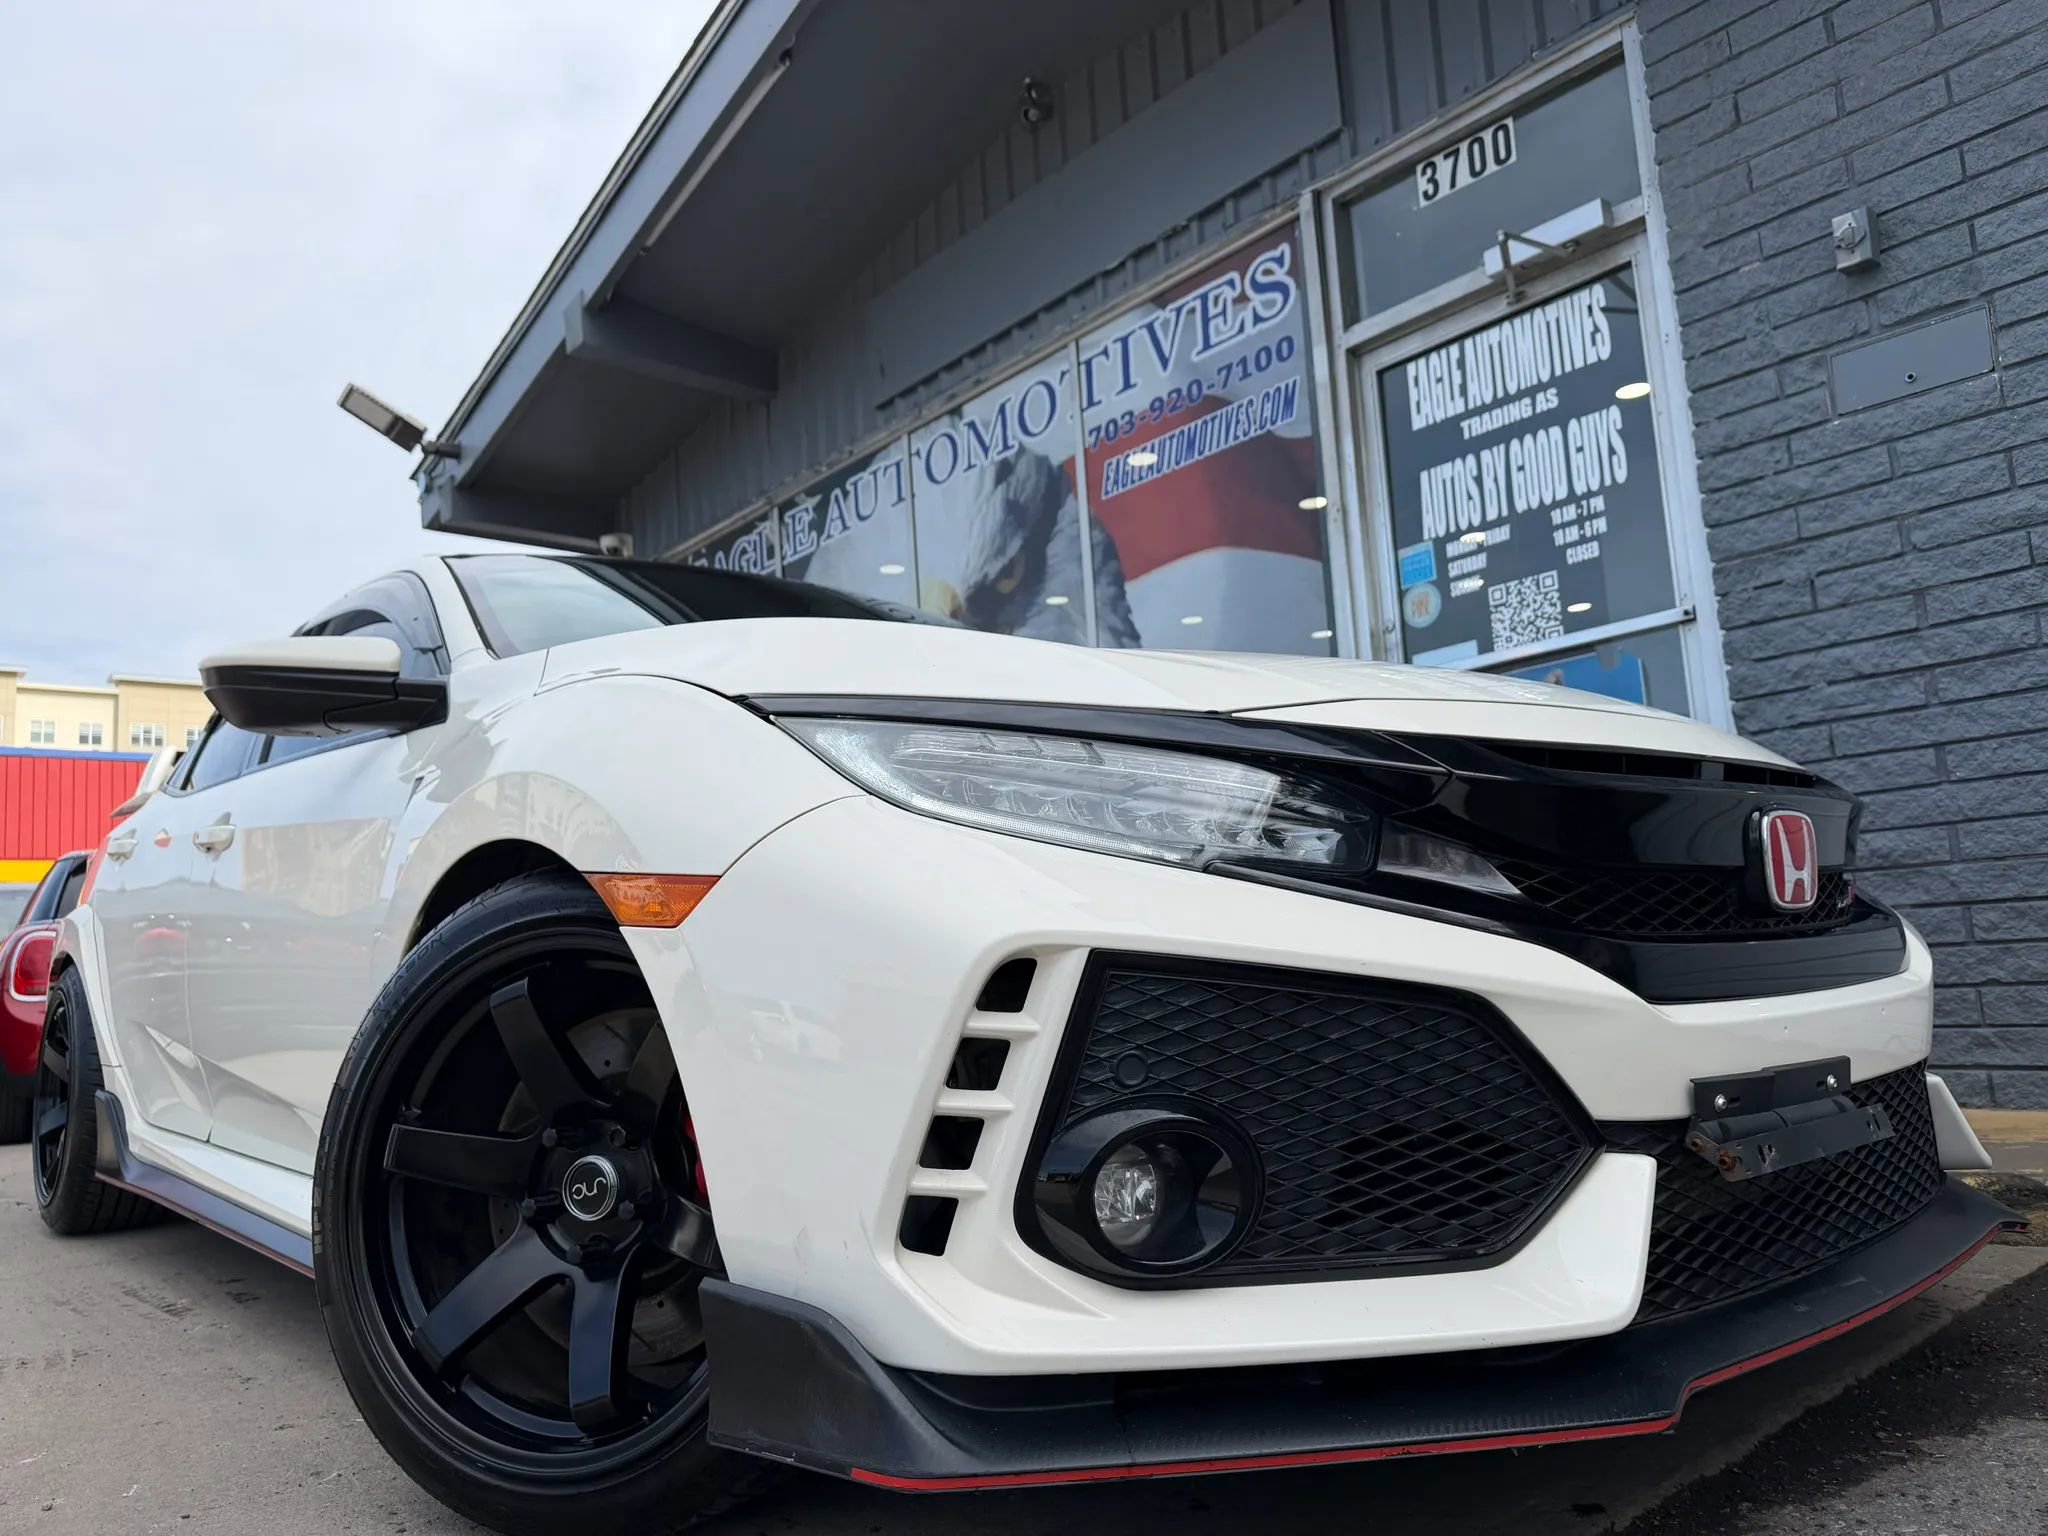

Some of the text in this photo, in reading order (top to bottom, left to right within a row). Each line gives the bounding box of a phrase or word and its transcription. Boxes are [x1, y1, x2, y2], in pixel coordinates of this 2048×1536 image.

[1420, 122, 1514, 202] 3700
[1406, 284, 1611, 431] EAGLE AUTOMOTIVES
[820, 243, 1296, 546] AUTOMOTIVES
[1088, 335, 1295, 451] 703-920-7100
[1460, 388, 1559, 439] TRADING AS
[1102, 376, 1300, 500] EAGLEAUTOMOTIVES.COM
[1419, 404, 1627, 540] AUTOS BY GOOD GUYS
[1483, 524, 1511, 547] FRIDAY
[1550, 507, 1562, 526] 10
[1562, 503, 1577, 523] AM
[1581, 500, 1588, 517] 7
[1588, 494, 1605, 515] PM
[1553, 528, 1564, 547] 10
[1564, 524, 1580, 544] AM
[1592, 515, 1607, 536] PM
[1448, 551, 1487, 578] SATURDAY
[1566, 540, 1599, 565] CLOSED
